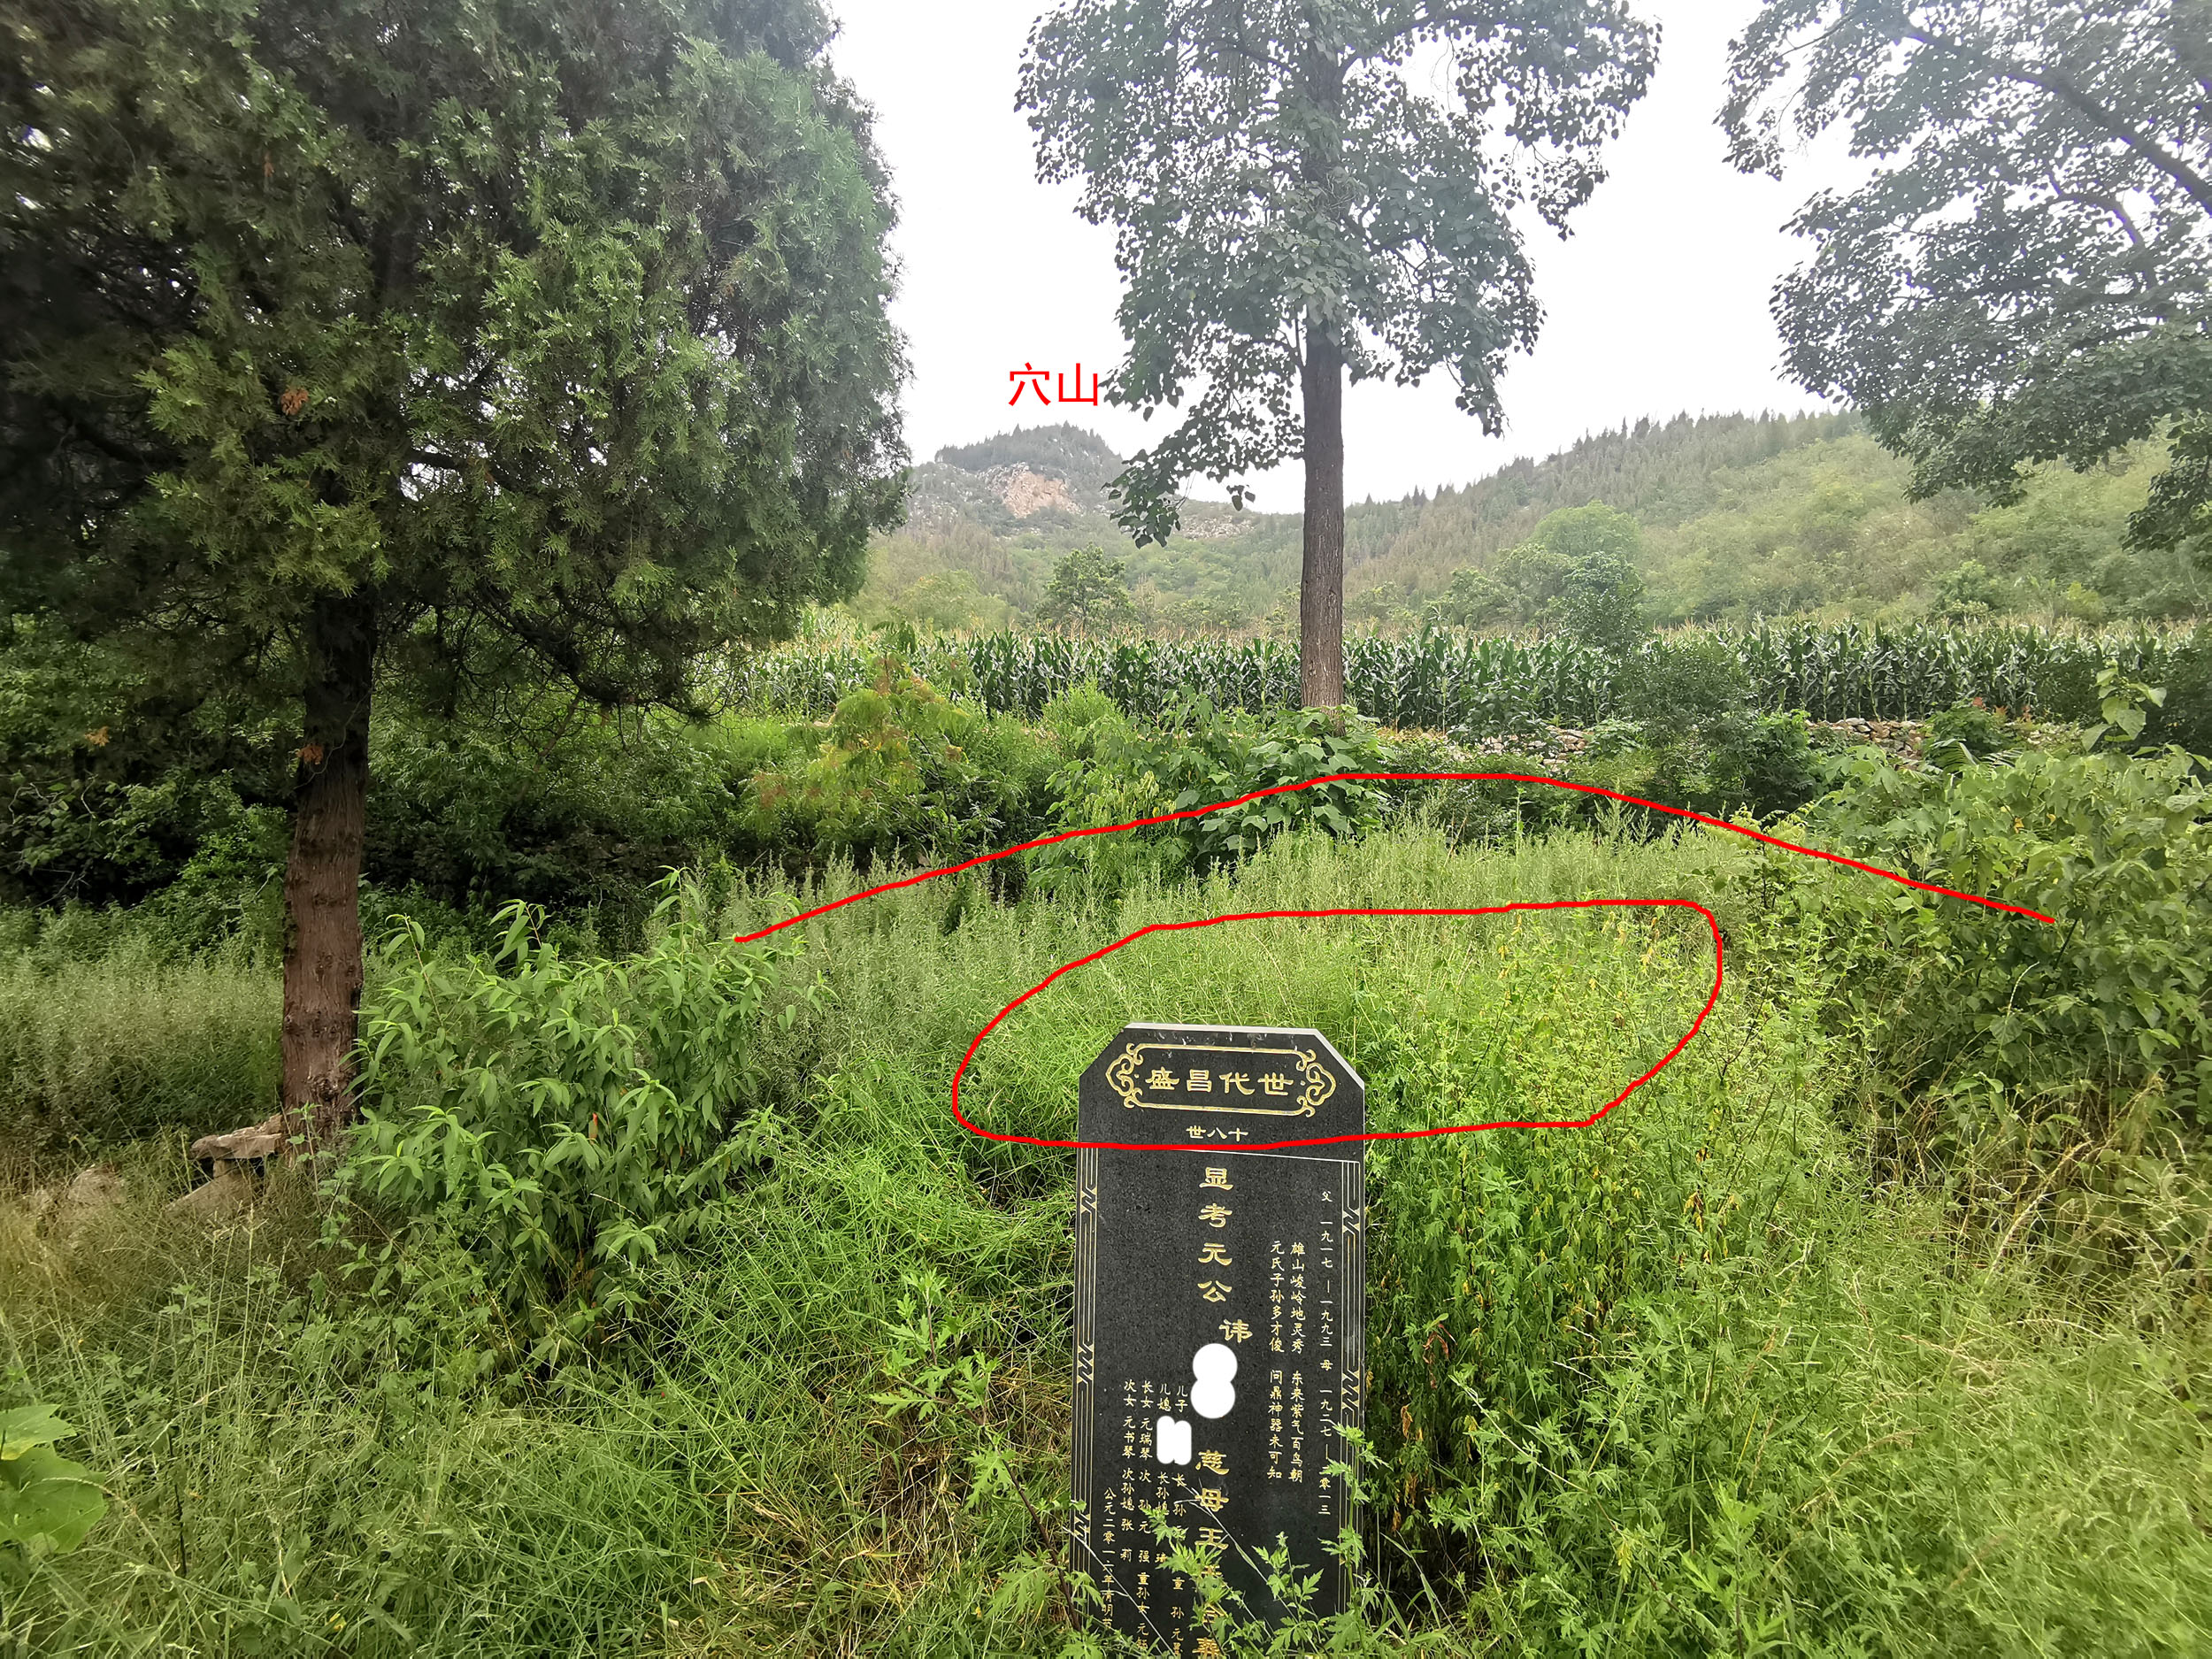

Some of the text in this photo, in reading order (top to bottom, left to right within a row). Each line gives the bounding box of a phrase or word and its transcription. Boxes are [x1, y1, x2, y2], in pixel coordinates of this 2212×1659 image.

[1321, 1191, 1333, 1202] 父
[1267, 1240, 1285, 1479] 元氏子孙多才俊 问鼎神器未可知
[1288, 1241, 1307, 1483] 雄山峻岭地灵秀 东来紫气百鸟朝
[1319, 1359, 1333, 1371] 母
[1123, 1379, 1137, 1407] 次女
[1140, 1380, 1154, 1409] 长女
[1156, 1383, 1172, 1411] 儿媳
[1175, 1385, 1188, 1412] 儿子
[1122, 1416, 1136, 1459] 元书琴
